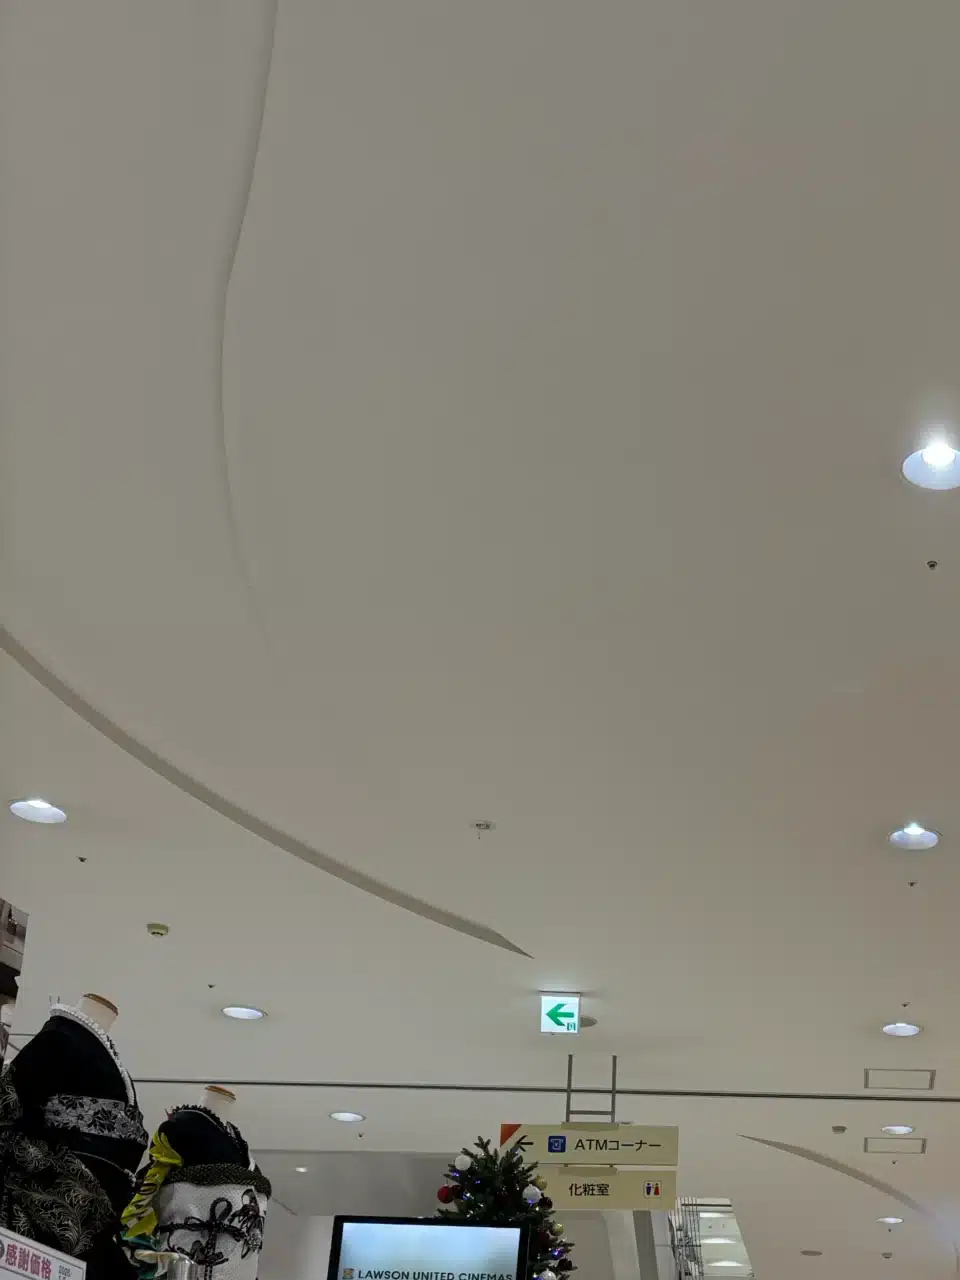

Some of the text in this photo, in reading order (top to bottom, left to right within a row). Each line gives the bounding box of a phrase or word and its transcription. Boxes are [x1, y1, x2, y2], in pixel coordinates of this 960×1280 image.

[574, 1139, 662, 1152] ATMコーナー
[568, 1183, 610, 1197] 化粧室
[5, 1243, 52, 1280] 感謝価格
[358, 1269, 409, 1280] LAWSON
